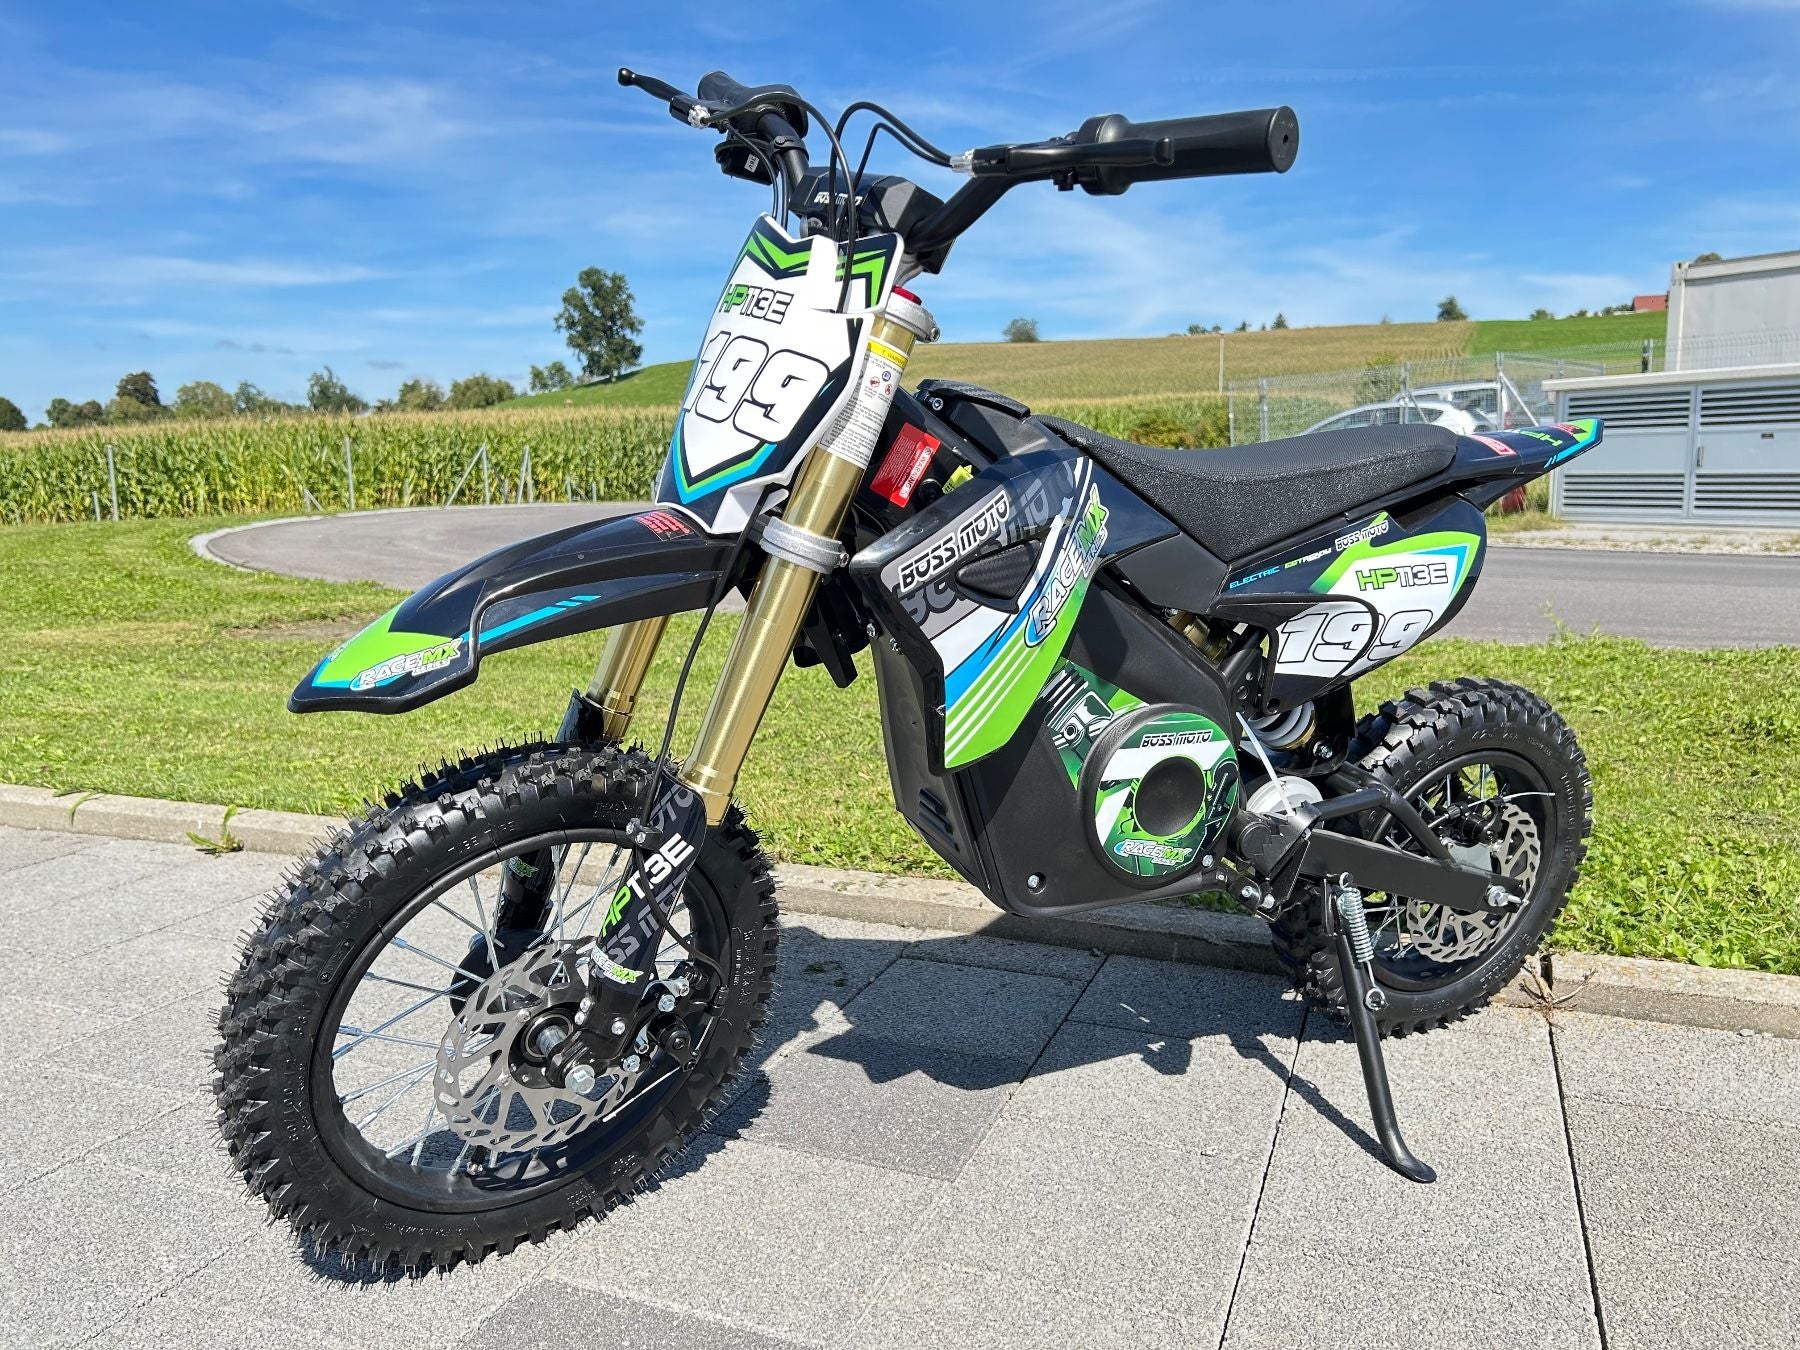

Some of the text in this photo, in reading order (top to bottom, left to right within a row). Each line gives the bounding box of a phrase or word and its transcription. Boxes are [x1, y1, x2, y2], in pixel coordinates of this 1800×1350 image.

[684, 330, 829, 444] 199
[905, 455, 928, 490] WARNING
[900, 492, 1009, 593] BOSS MOTO
[1335, 520, 1388, 552] BOSS MOTO
[1229, 566, 1281, 590] ELECTRIC
[1278, 609, 1434, 664] 199
[1141, 730, 1212, 748] BOSS MOTO
